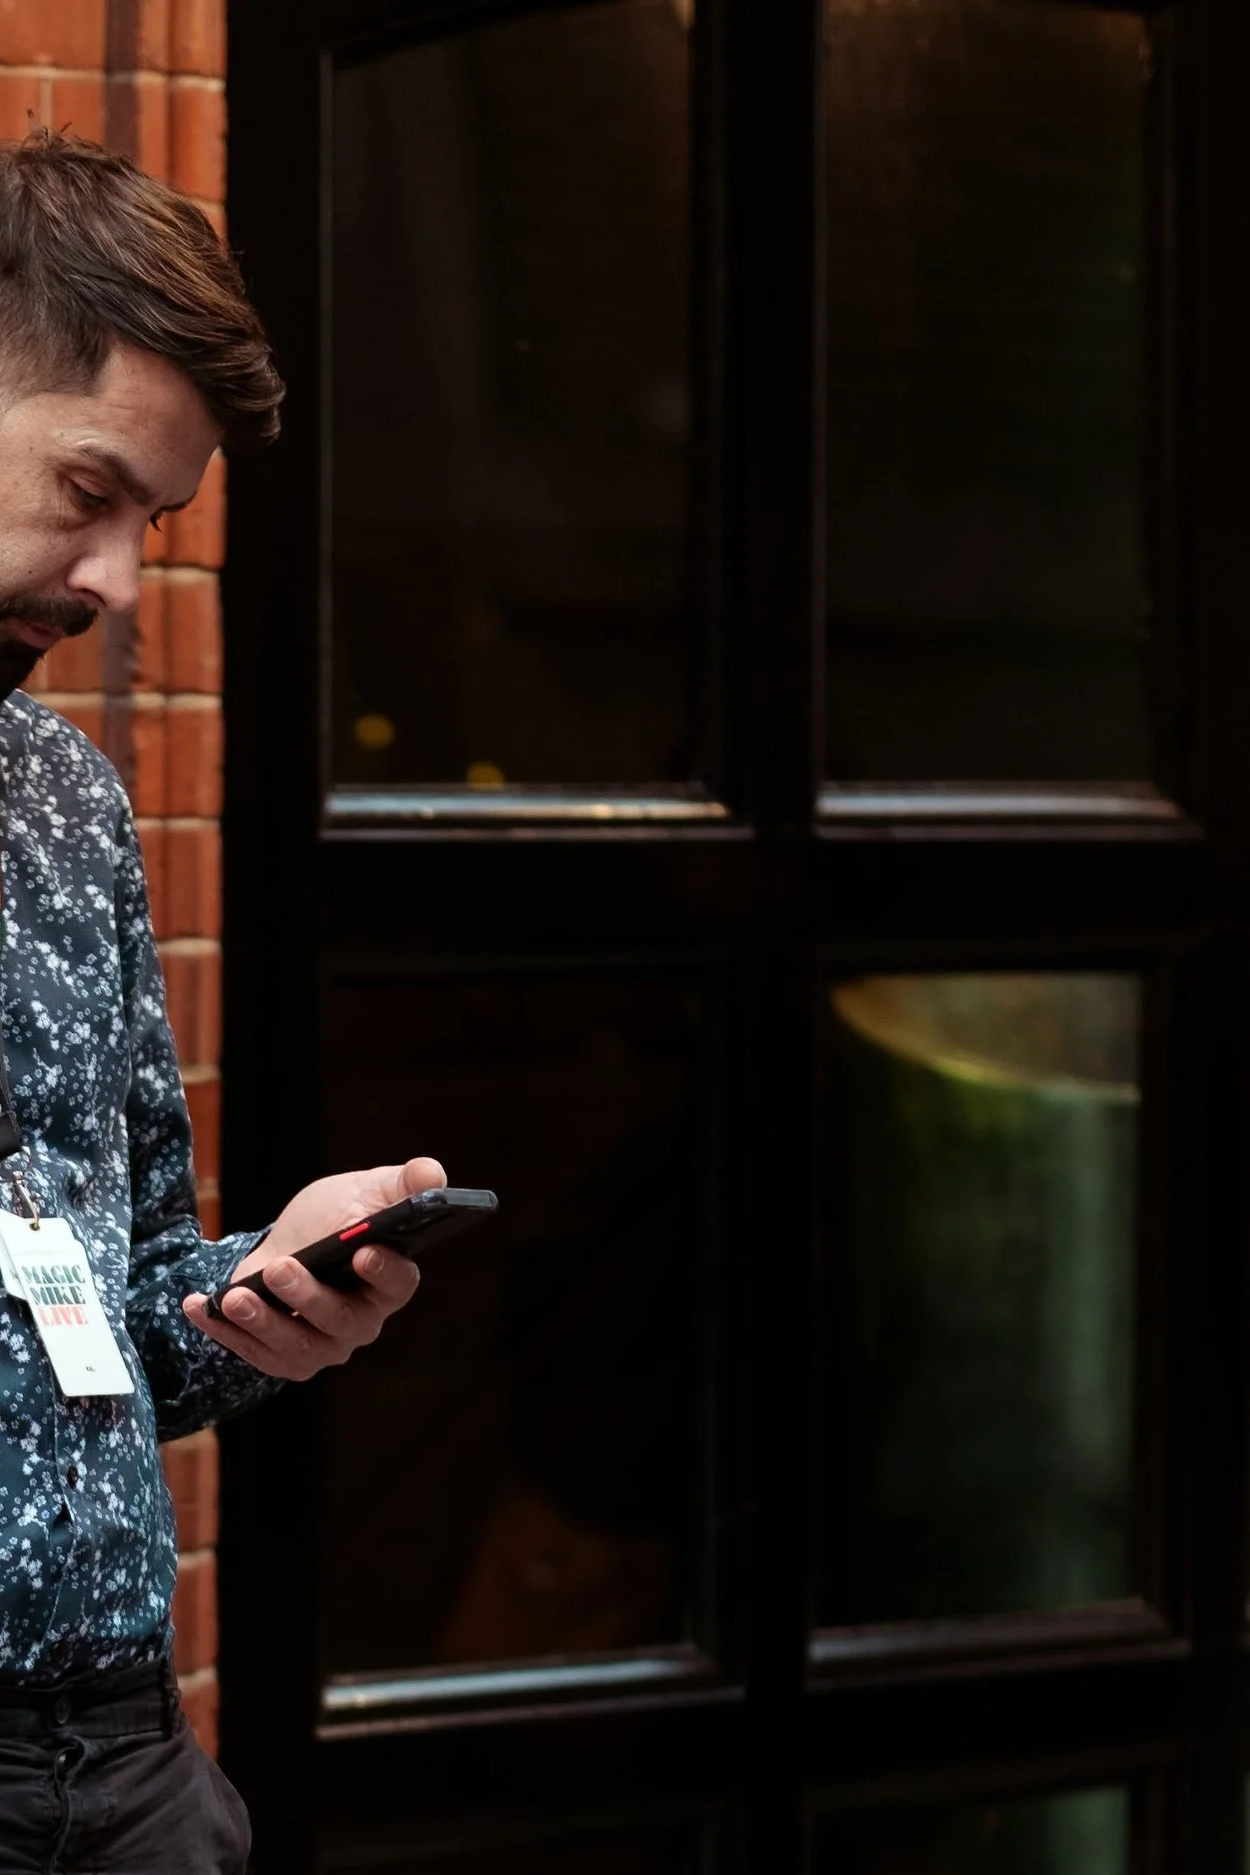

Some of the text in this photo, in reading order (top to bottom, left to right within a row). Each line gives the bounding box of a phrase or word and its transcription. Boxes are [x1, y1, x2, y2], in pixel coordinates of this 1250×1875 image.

[21, 1265, 87, 1285] MAGIC
[30, 1286, 87, 1305] MIKE
[38, 1306, 89, 1326] LIVE
